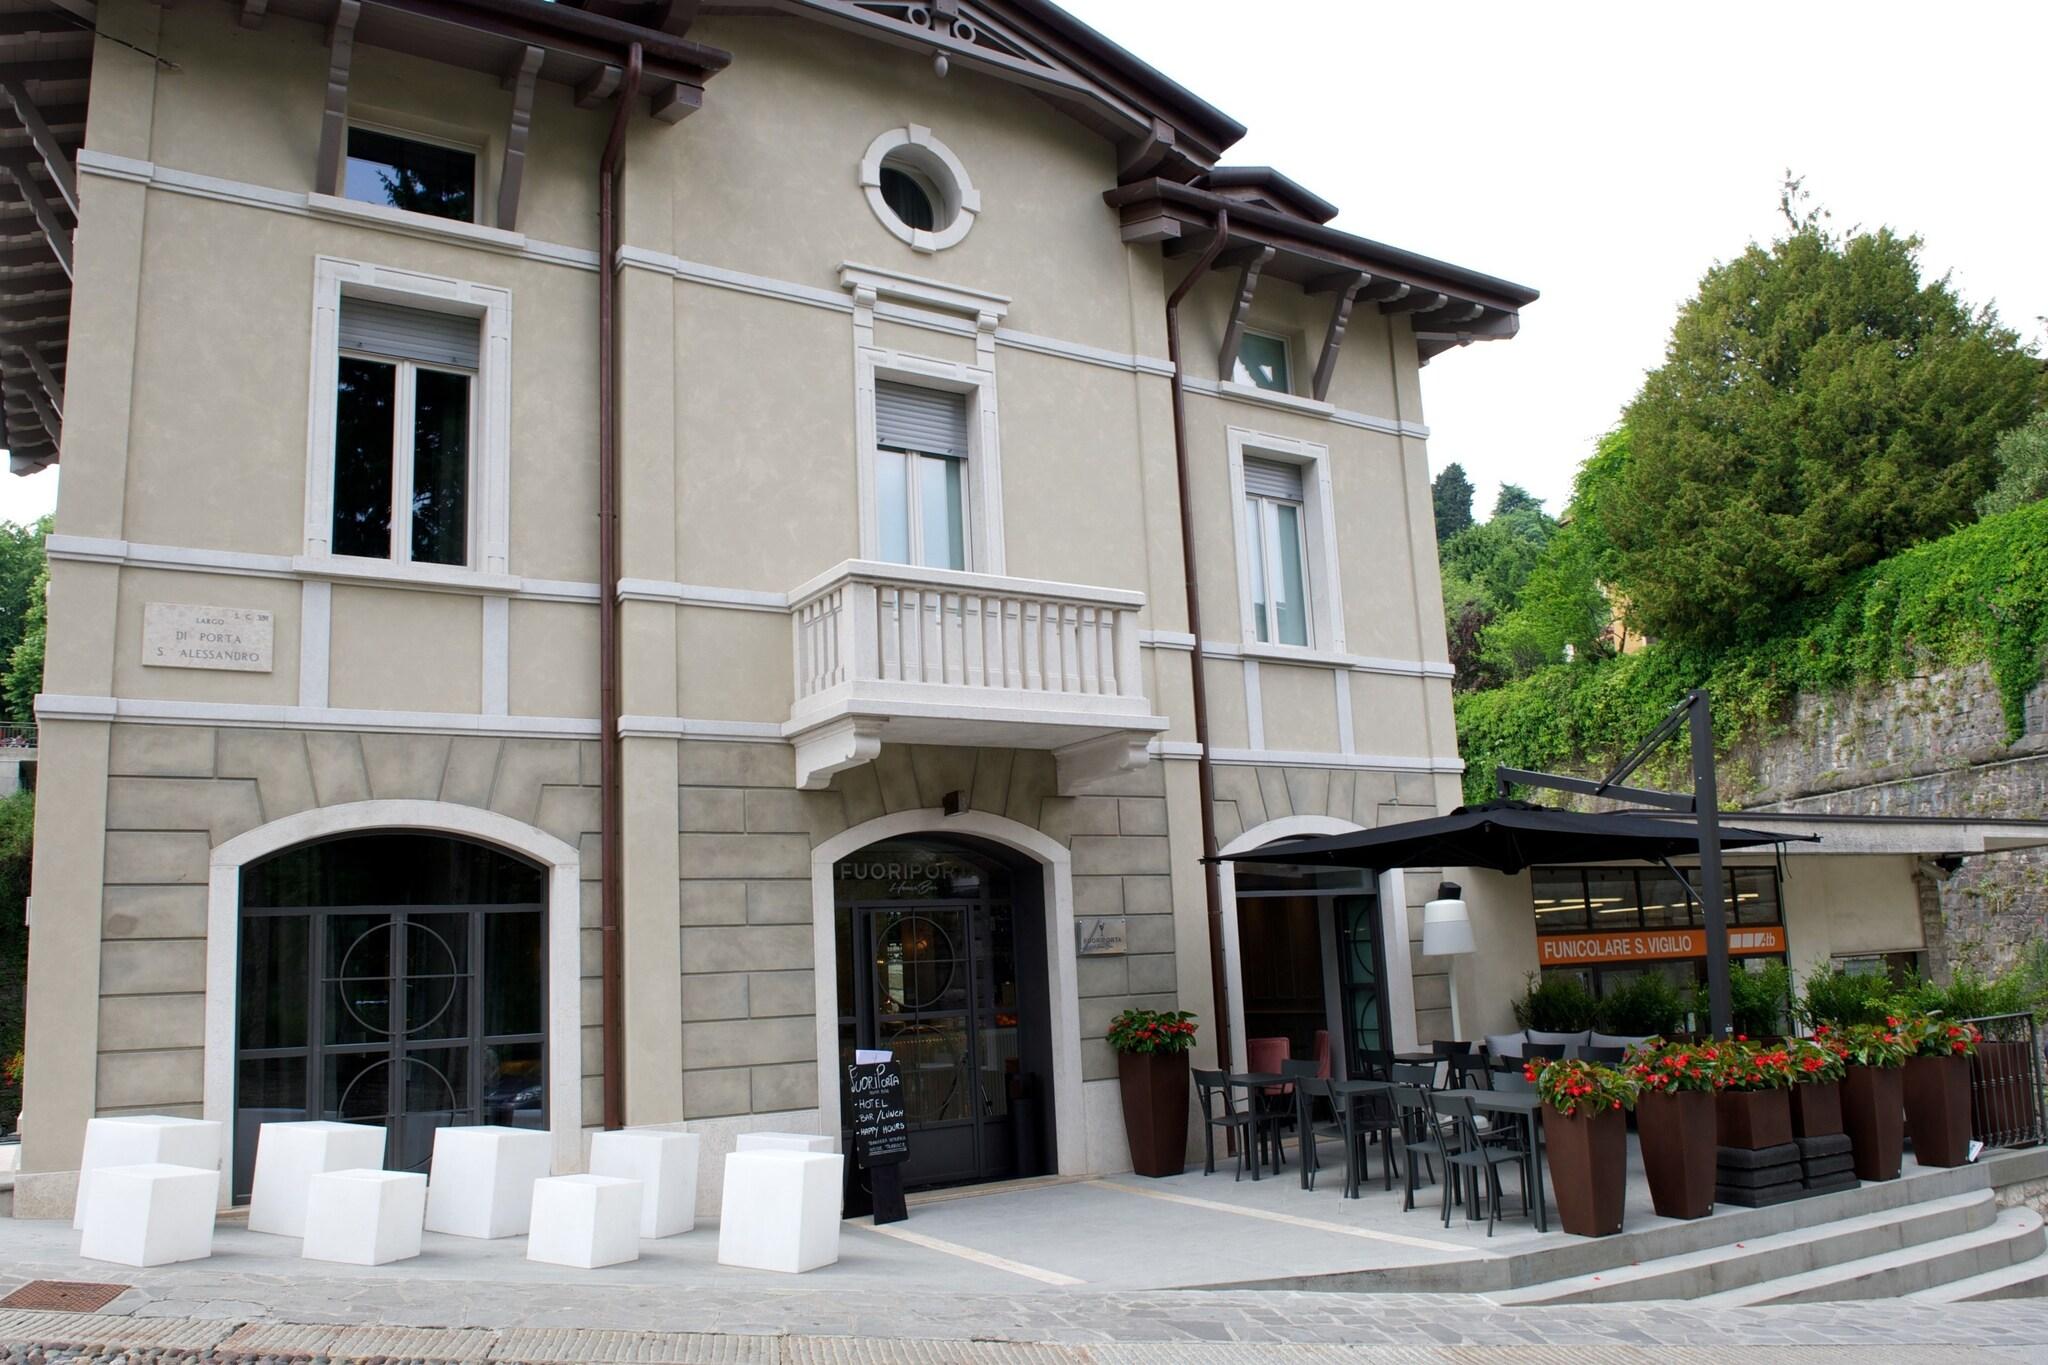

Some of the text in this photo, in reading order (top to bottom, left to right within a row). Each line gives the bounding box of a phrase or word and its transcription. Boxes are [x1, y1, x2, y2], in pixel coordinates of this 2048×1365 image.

[175, 631, 242, 644] DI PORTA
[180, 649, 260, 662] ALESSANDRO
[1544, 935, 1692, 959] FUNICOLARE S. VIGILIO
[859, 1099, 888, 1108] HOTEL
[860, 1113, 874, 1122] BAR
[860, 1122, 905, 1138] HAPPY HOURS
